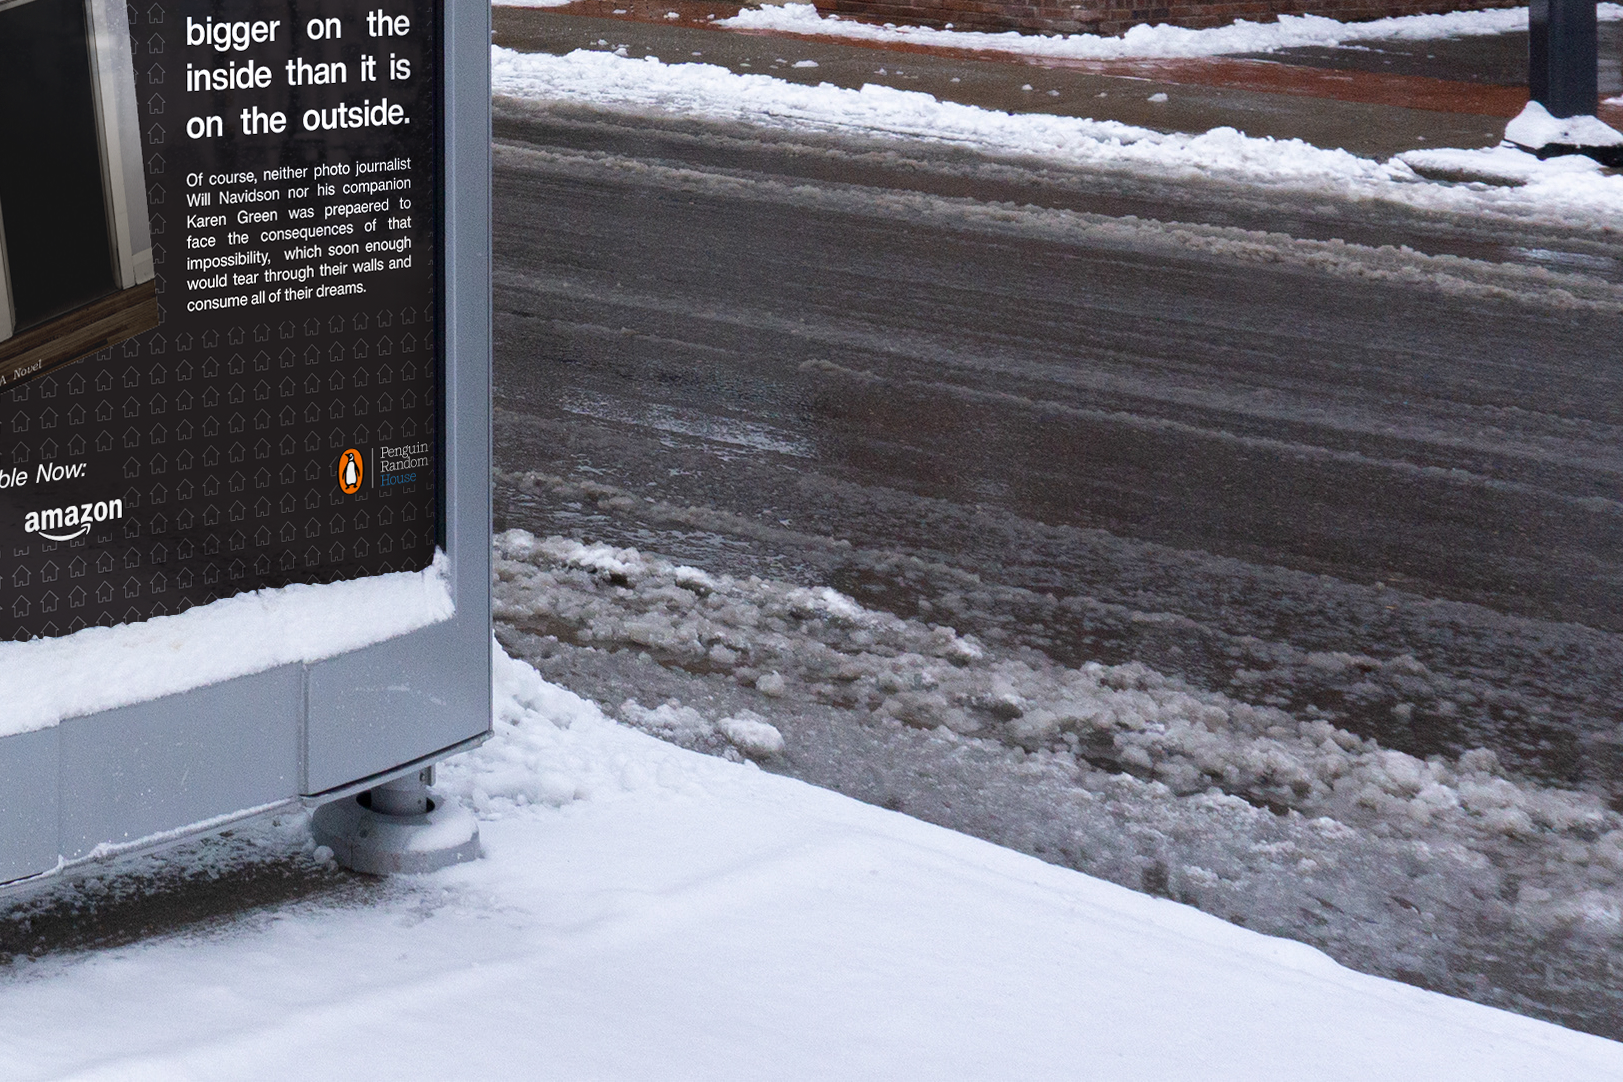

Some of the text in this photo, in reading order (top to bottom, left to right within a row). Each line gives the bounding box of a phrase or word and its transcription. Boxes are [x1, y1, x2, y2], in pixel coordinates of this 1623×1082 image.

[186, 9, 410, 52] bigger on the
[186, 52, 411, 92] inside than it is
[186, 98, 411, 140] on the outside.
[186, 157, 412, 188] Of course, neither photo journalist
[186, 178, 412, 208] Will Navidson nor his companion
[186, 196, 412, 229] Karen Green was prepaered to
[186, 215, 412, 249] face the consequences of that
[186, 235, 412, 272] impossibility, which soon enough
[186, 255, 412, 291] would tear through their walls and
[186, 281, 367, 312] consume all of their dreams.
[13, 359, 43, 381] Novel
[380, 441, 429, 459] Penguin
[380, 456, 429, 474] Random
[35, 462, 87, 484] Now:
[380, 472, 417, 487] House
[24, 498, 123, 534] amazon
